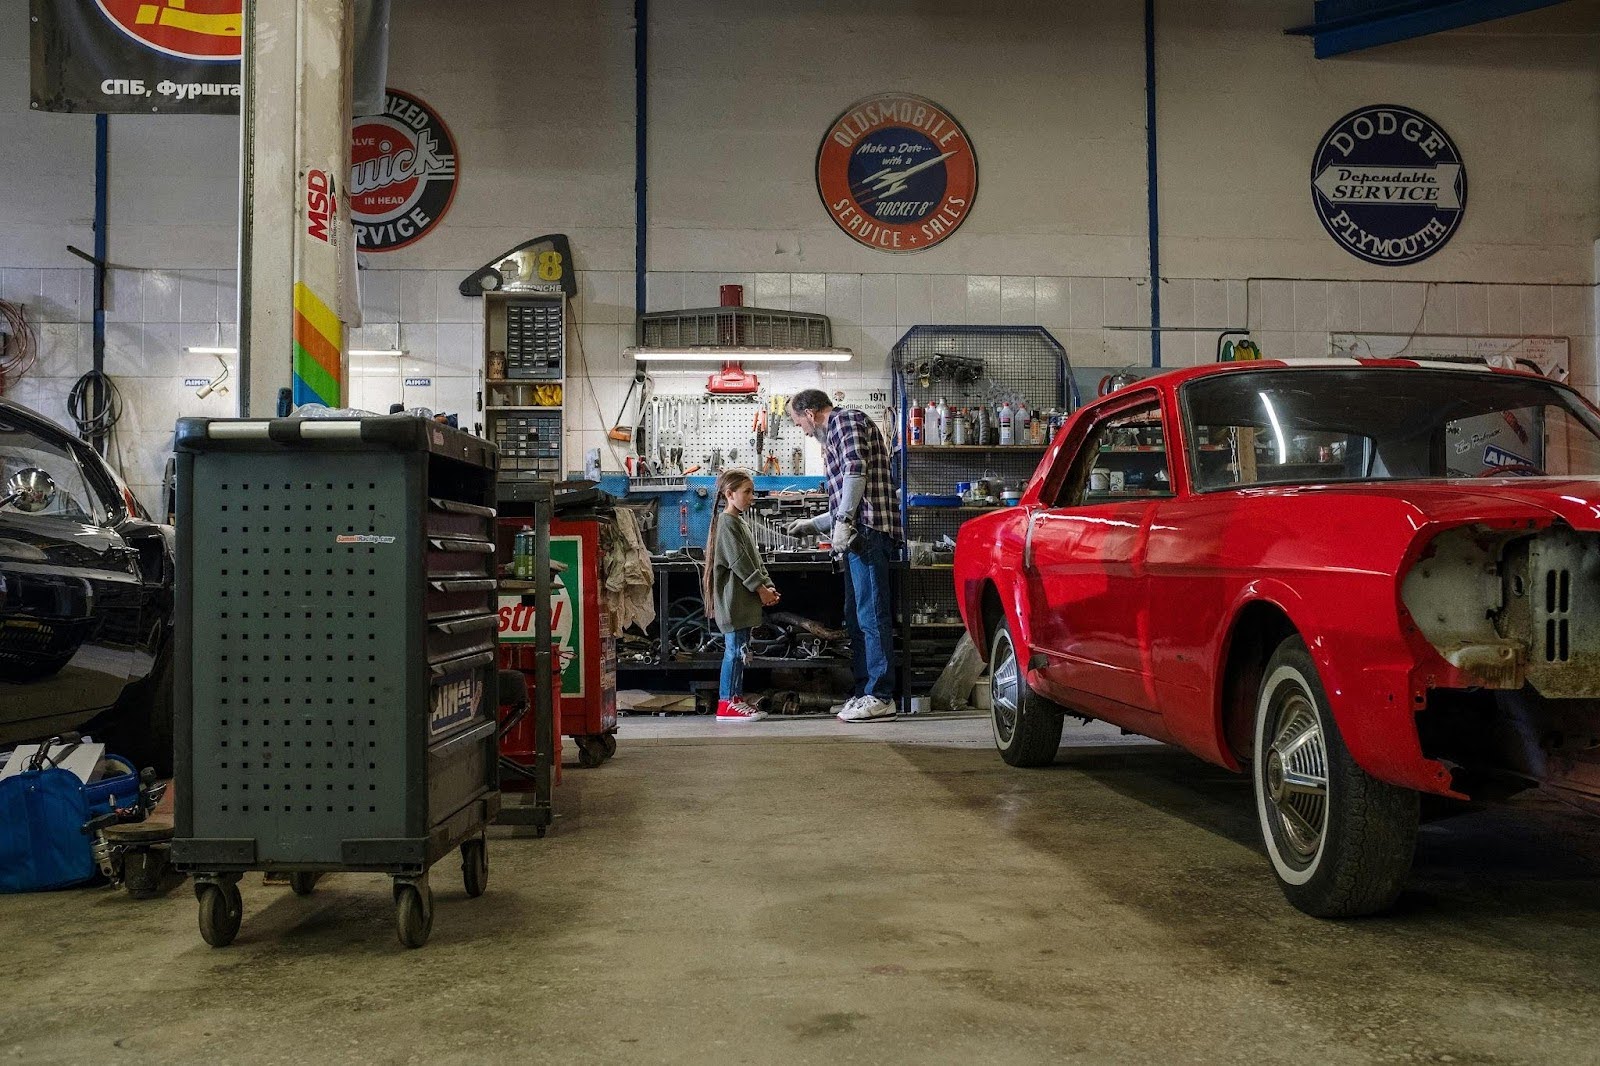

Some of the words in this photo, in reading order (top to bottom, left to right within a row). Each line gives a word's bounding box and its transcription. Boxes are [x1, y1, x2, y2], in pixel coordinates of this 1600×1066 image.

[100, 79, 152, 97] СПБ,
[833, 101, 959, 147] OLDSMOBILE
[1330, 112, 1446, 159] DODGE
[856, 143, 886, 155] Make
[889, 145, 895, 153] a
[882, 155, 902, 165] with
[906, 157, 912, 165] a
[1338, 169, 1437, 184] Dependable
[364, 197, 375, 205] IN
[378, 197, 405, 205] HEAD
[1332, 185, 1440, 201] SERVICE
[308, 169, 328, 242] MSD
[833, 198, 902, 247] SERVICE
[921, 195, 966, 240] SALES
[1330, 210, 1447, 257] PLYMOUTH
[498, 601, 564, 632] strl
